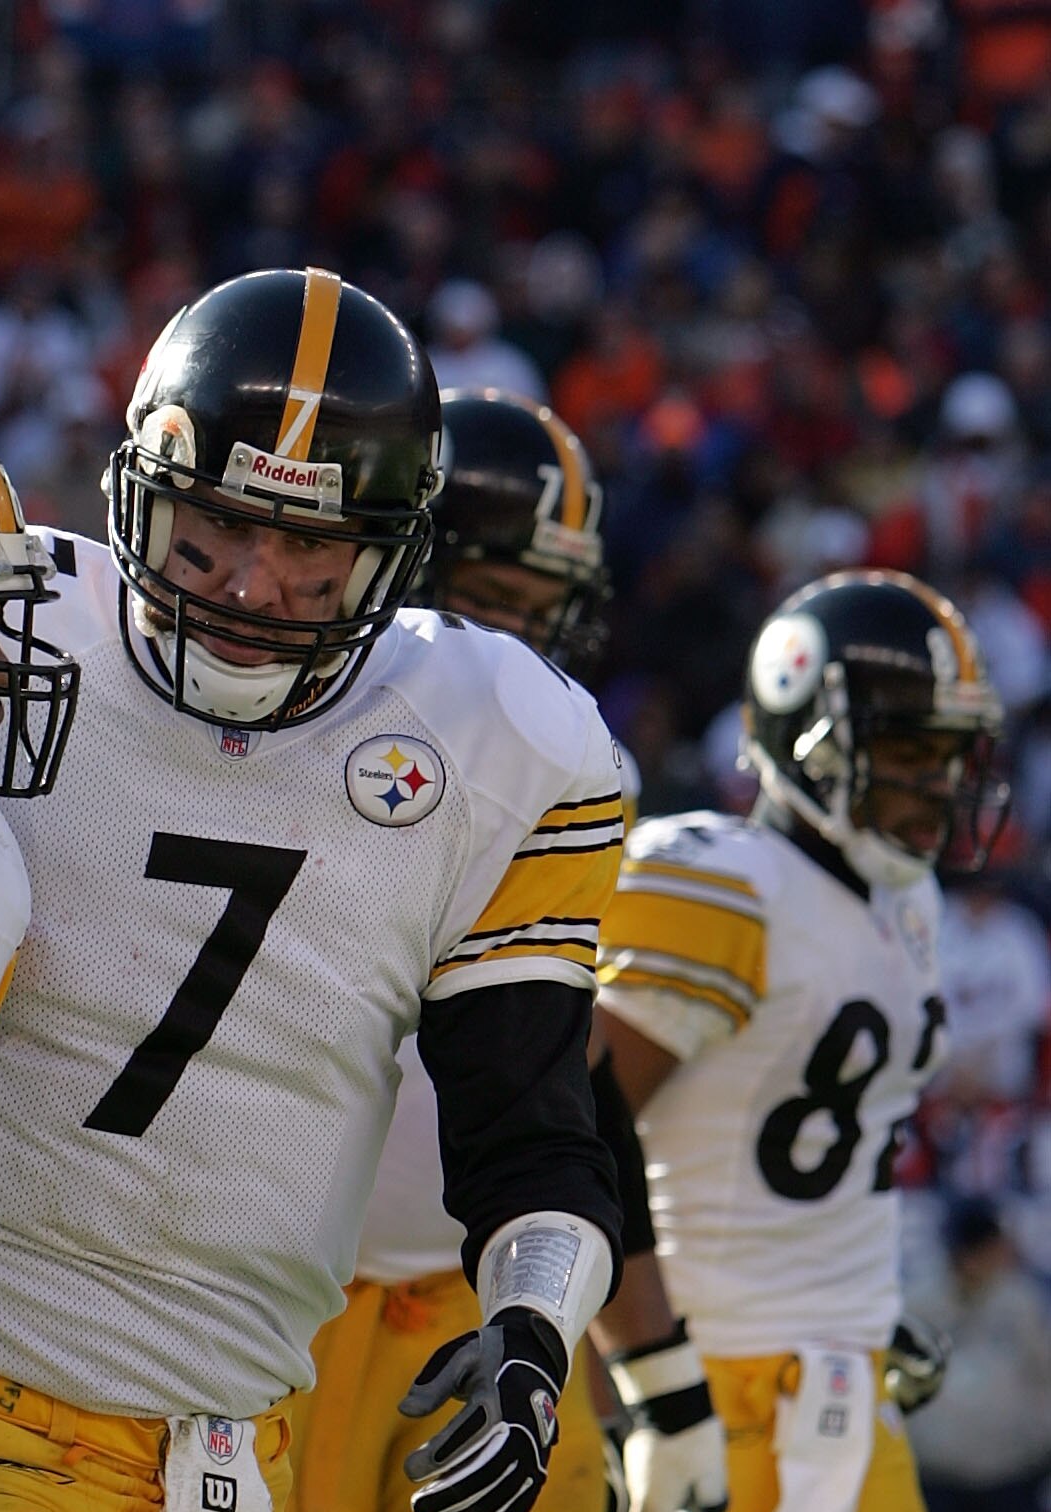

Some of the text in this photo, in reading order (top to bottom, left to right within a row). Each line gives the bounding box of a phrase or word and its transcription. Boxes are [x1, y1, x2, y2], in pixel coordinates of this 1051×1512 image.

[273, 388, 323, 457] 7
[251, 454, 318, 488] Riddell
[81, 830, 309, 1138] 7
[209, 1431, 232, 1455] NFL
